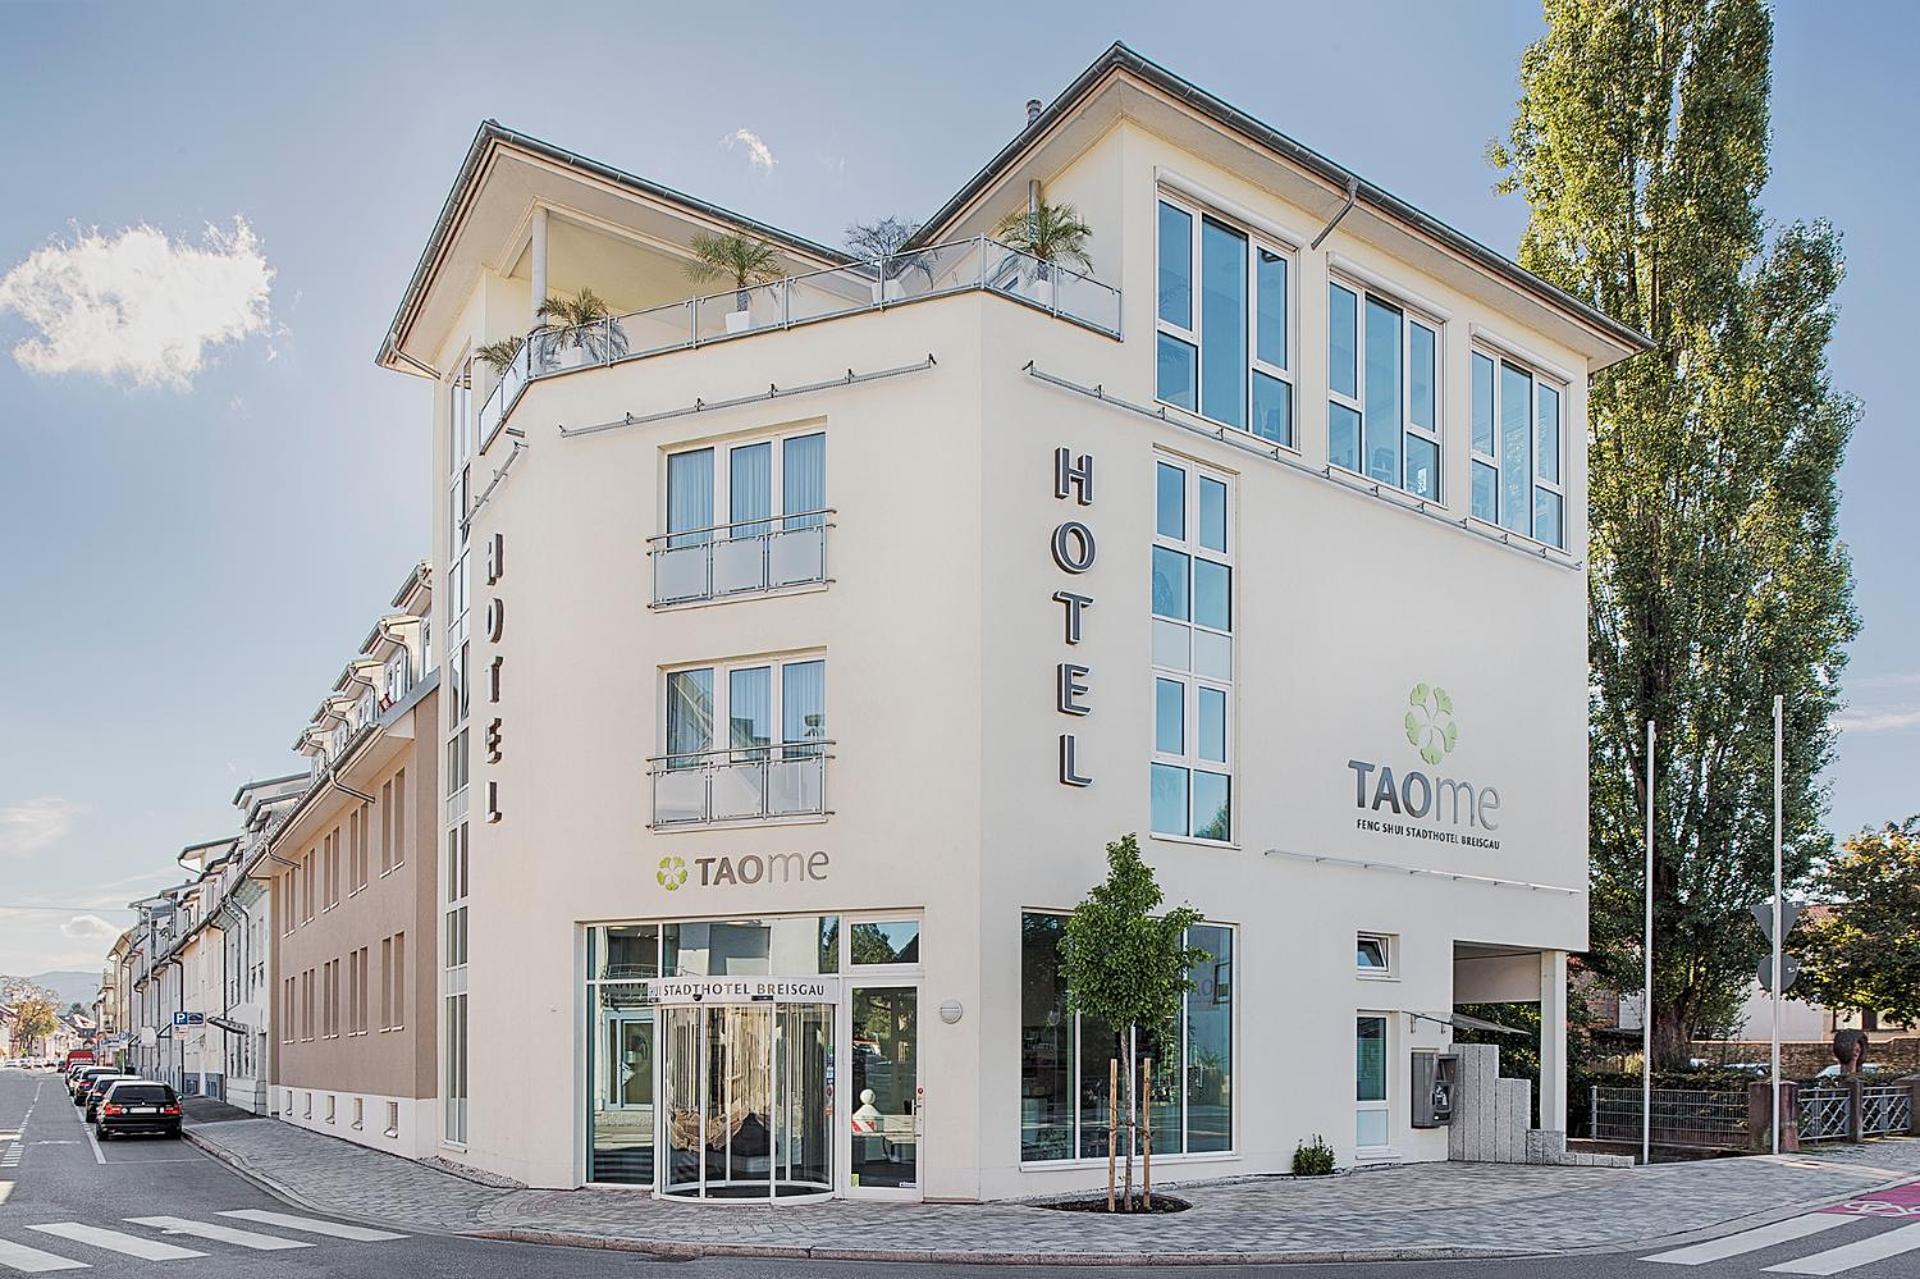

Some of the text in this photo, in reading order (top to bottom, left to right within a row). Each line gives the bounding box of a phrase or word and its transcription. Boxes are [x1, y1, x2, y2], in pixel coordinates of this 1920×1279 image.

[1050, 447, 1096, 787] HOTEL
[1348, 759, 1500, 831] TAOme
[1356, 819, 1500, 850] FENG SHUI STADTHOTEL BREISGAU
[694, 851, 829, 886] TAOme
[664, 983, 824, 996] STADTHOTEL BREISGAU
[176, 1013, 186, 1023] P
